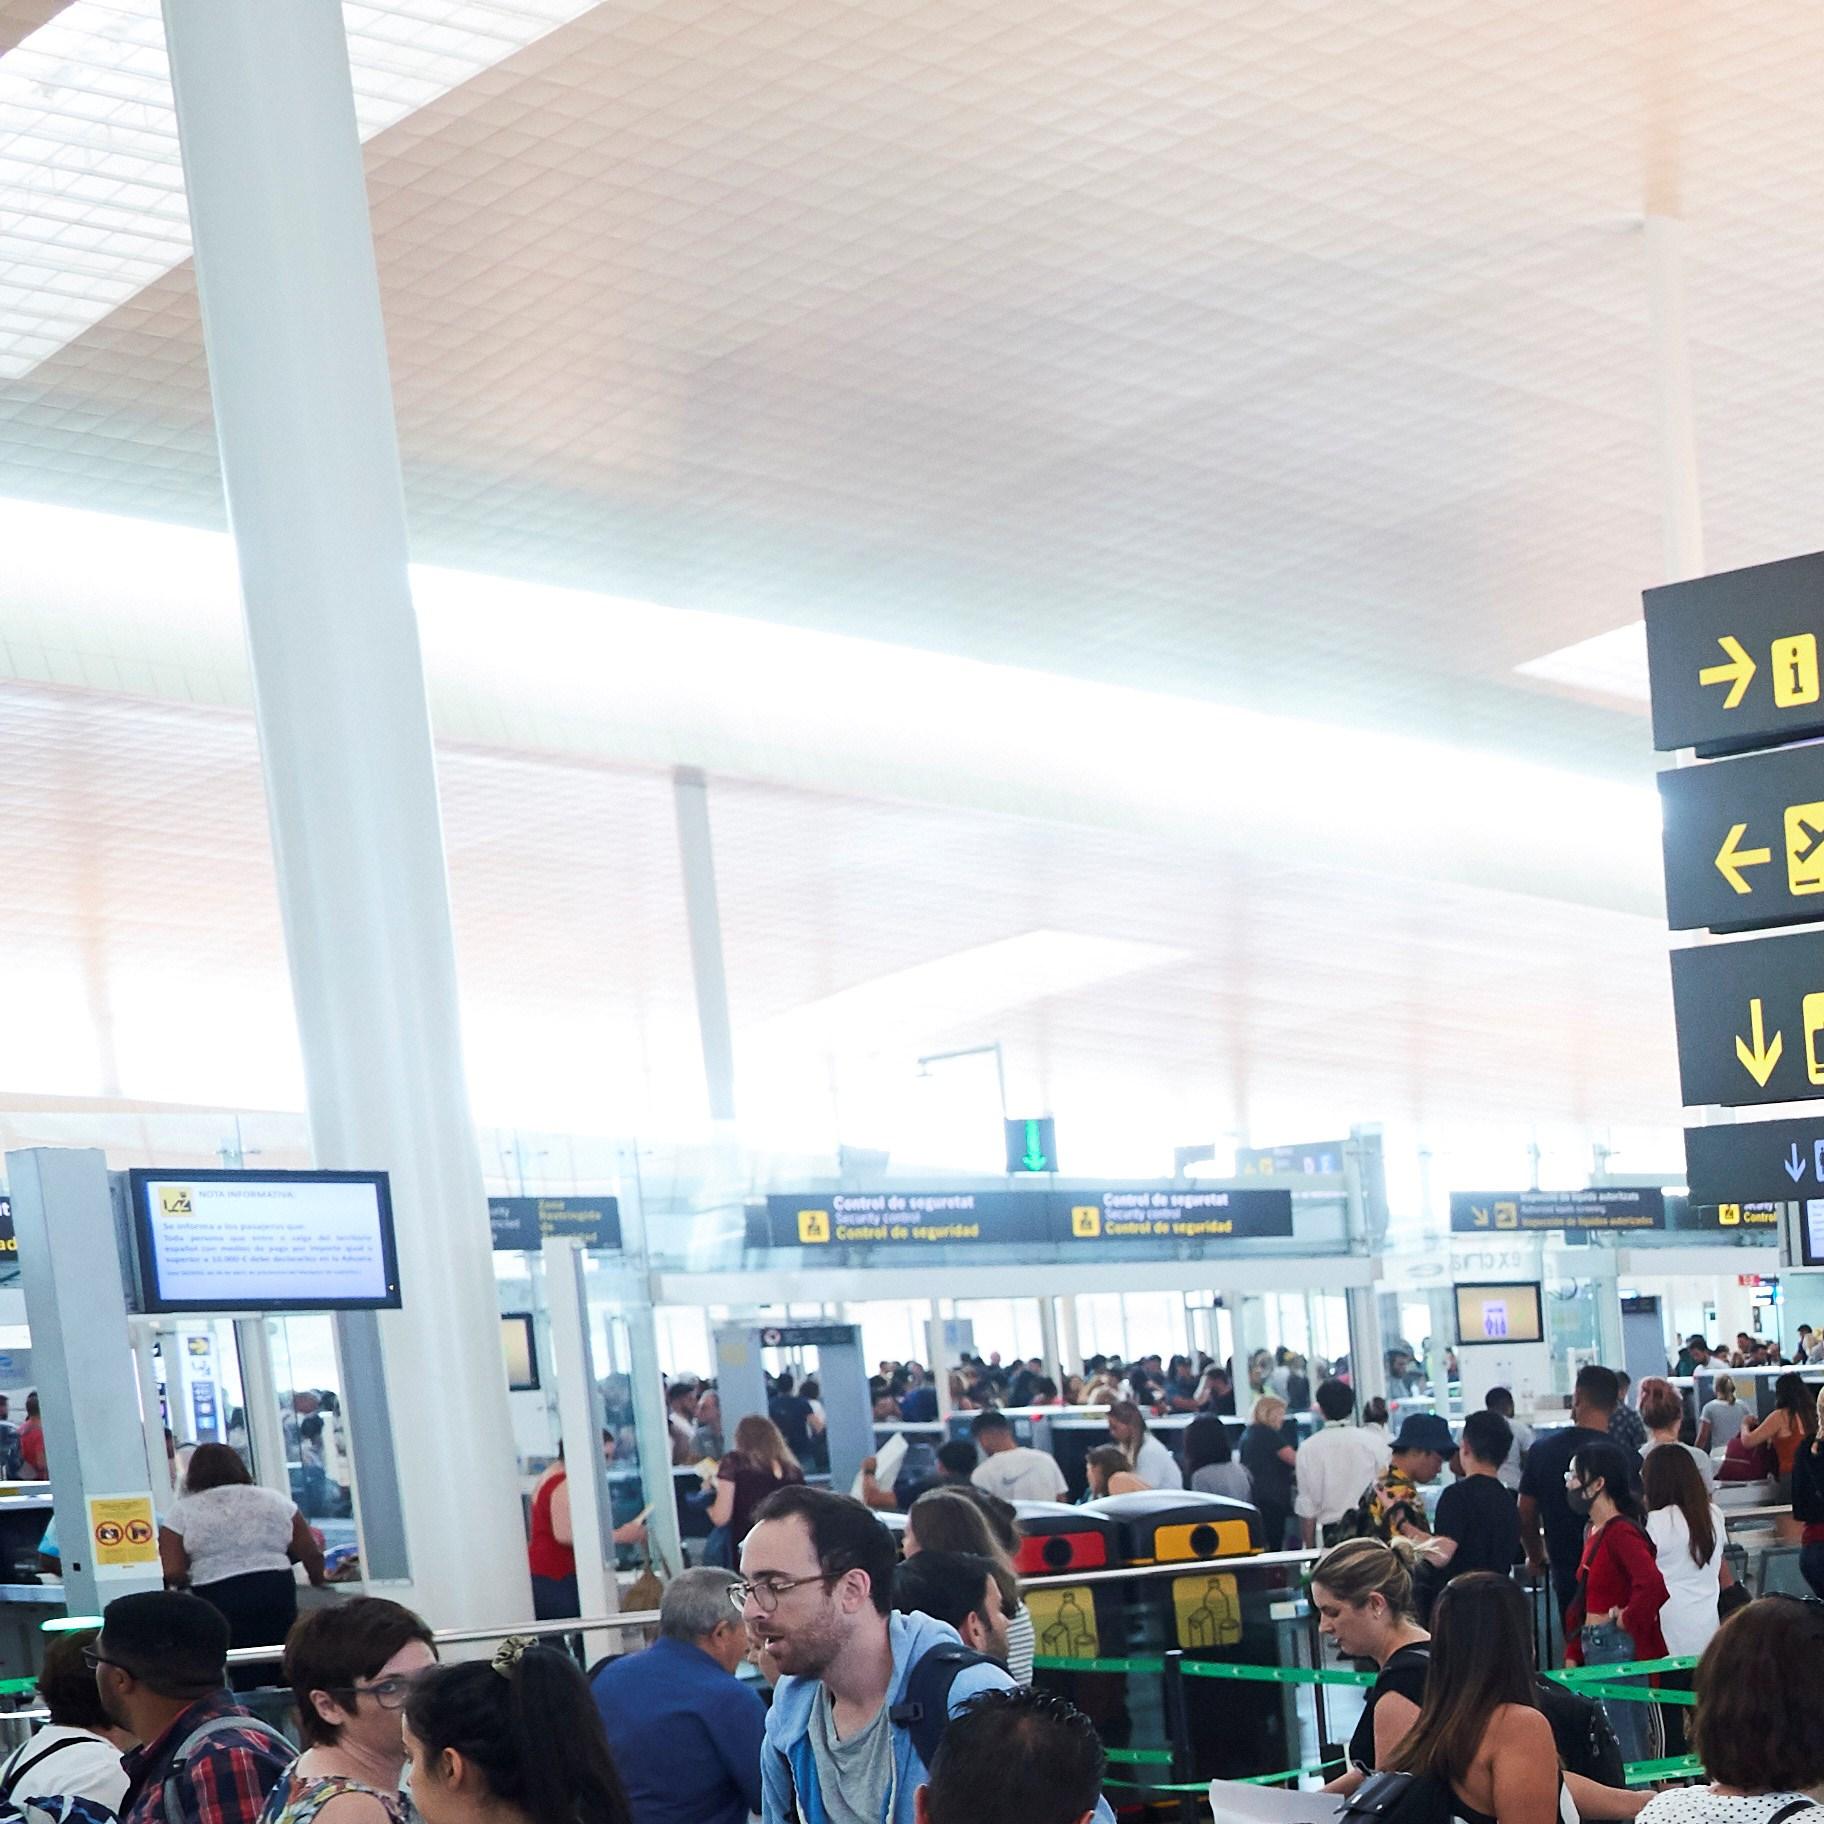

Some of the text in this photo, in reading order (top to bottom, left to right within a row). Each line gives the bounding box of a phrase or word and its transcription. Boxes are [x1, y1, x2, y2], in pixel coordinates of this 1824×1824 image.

[833, 1194, 976, 1212] Control de seguretat
[1103, 1192, 1150, 1207] Control
[1151, 1192, 1169, 1207] de
[836, 1222, 980, 1241] Control de seguridad
[1105, 1220, 1151, 1235] Control
[1153, 1220, 1170, 1235] de
